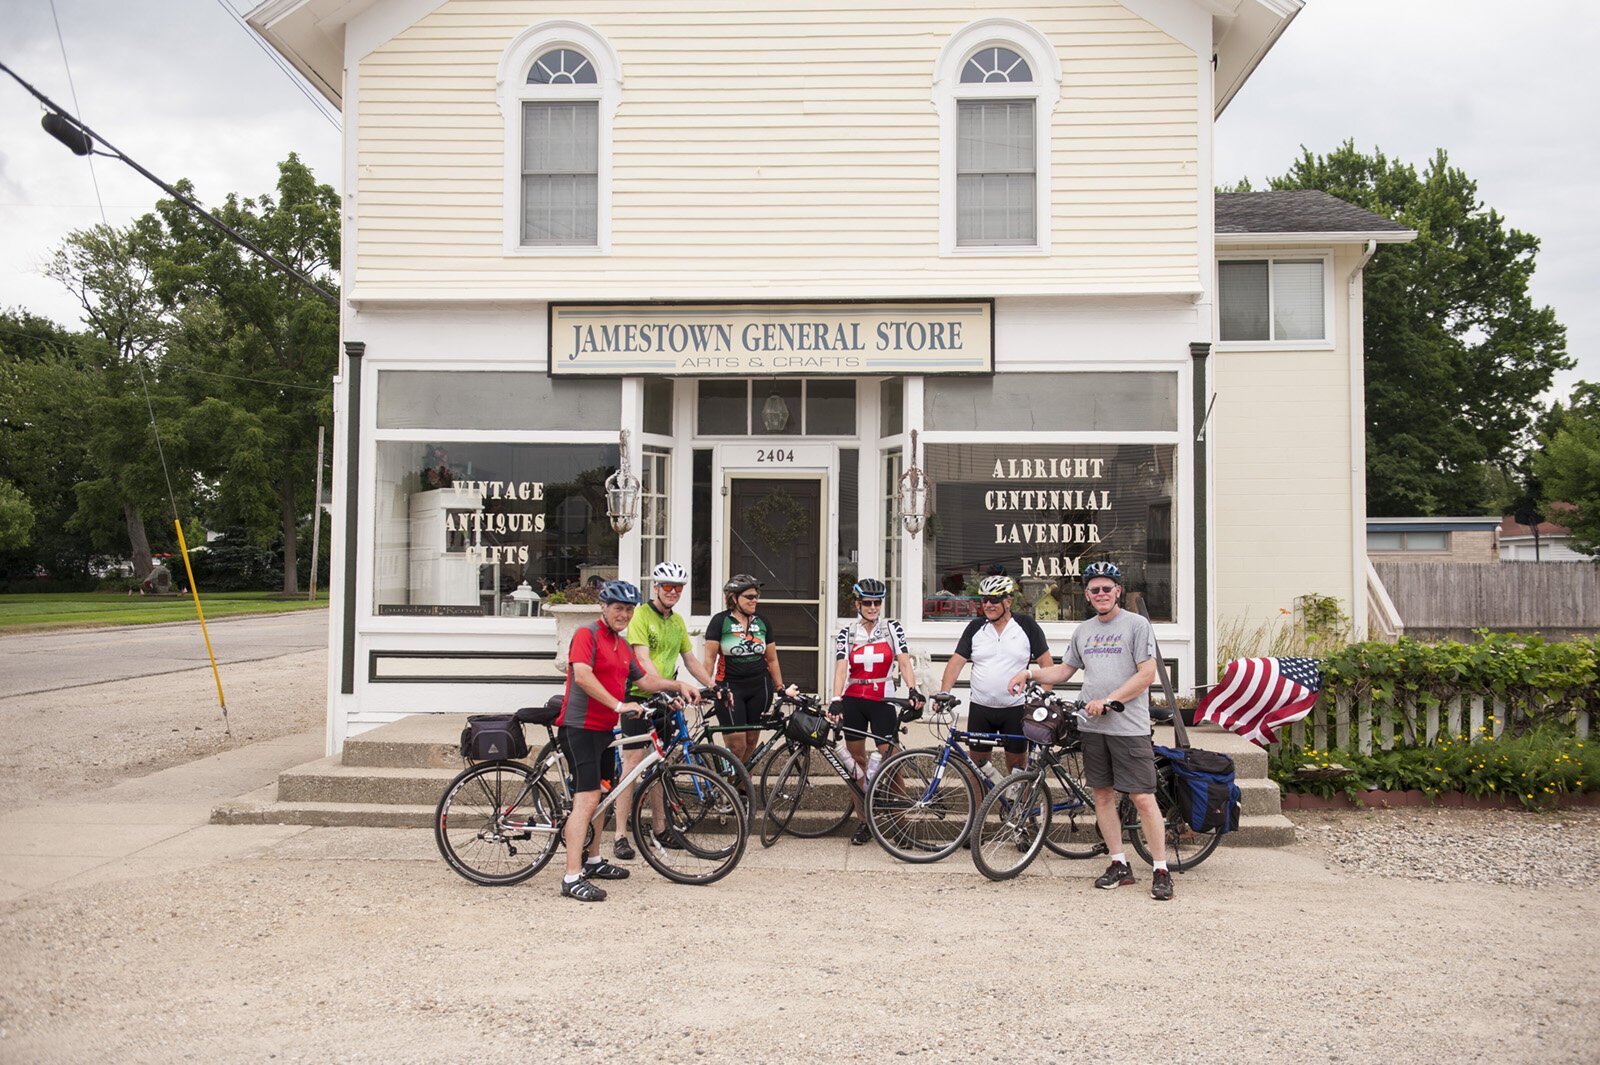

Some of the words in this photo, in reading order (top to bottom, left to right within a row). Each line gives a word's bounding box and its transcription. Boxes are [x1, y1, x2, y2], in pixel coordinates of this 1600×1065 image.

[569, 323, 733, 361] JAMESTOWN
[741, 322, 866, 352] GENERAL
[875, 321, 964, 351] STORE
[681, 356, 740, 369] ARTS
[748, 356, 765, 368] &
[773, 356, 861, 368] CRAFTS
[756, 449, 795, 463] 2404
[992, 458, 1104, 479] ALBRIGHT
[452, 480, 544, 501] VINTAGE
[984, 490, 1112, 511] CENTENNIAL
[445, 512, 546, 535] ANTIQUES
[994, 523, 1102, 544] LAVENDER
[465, 545, 530, 565] GIFTS
[1020, 556, 1082, 577] FARM
[923, 599, 984, 615] OPEN
